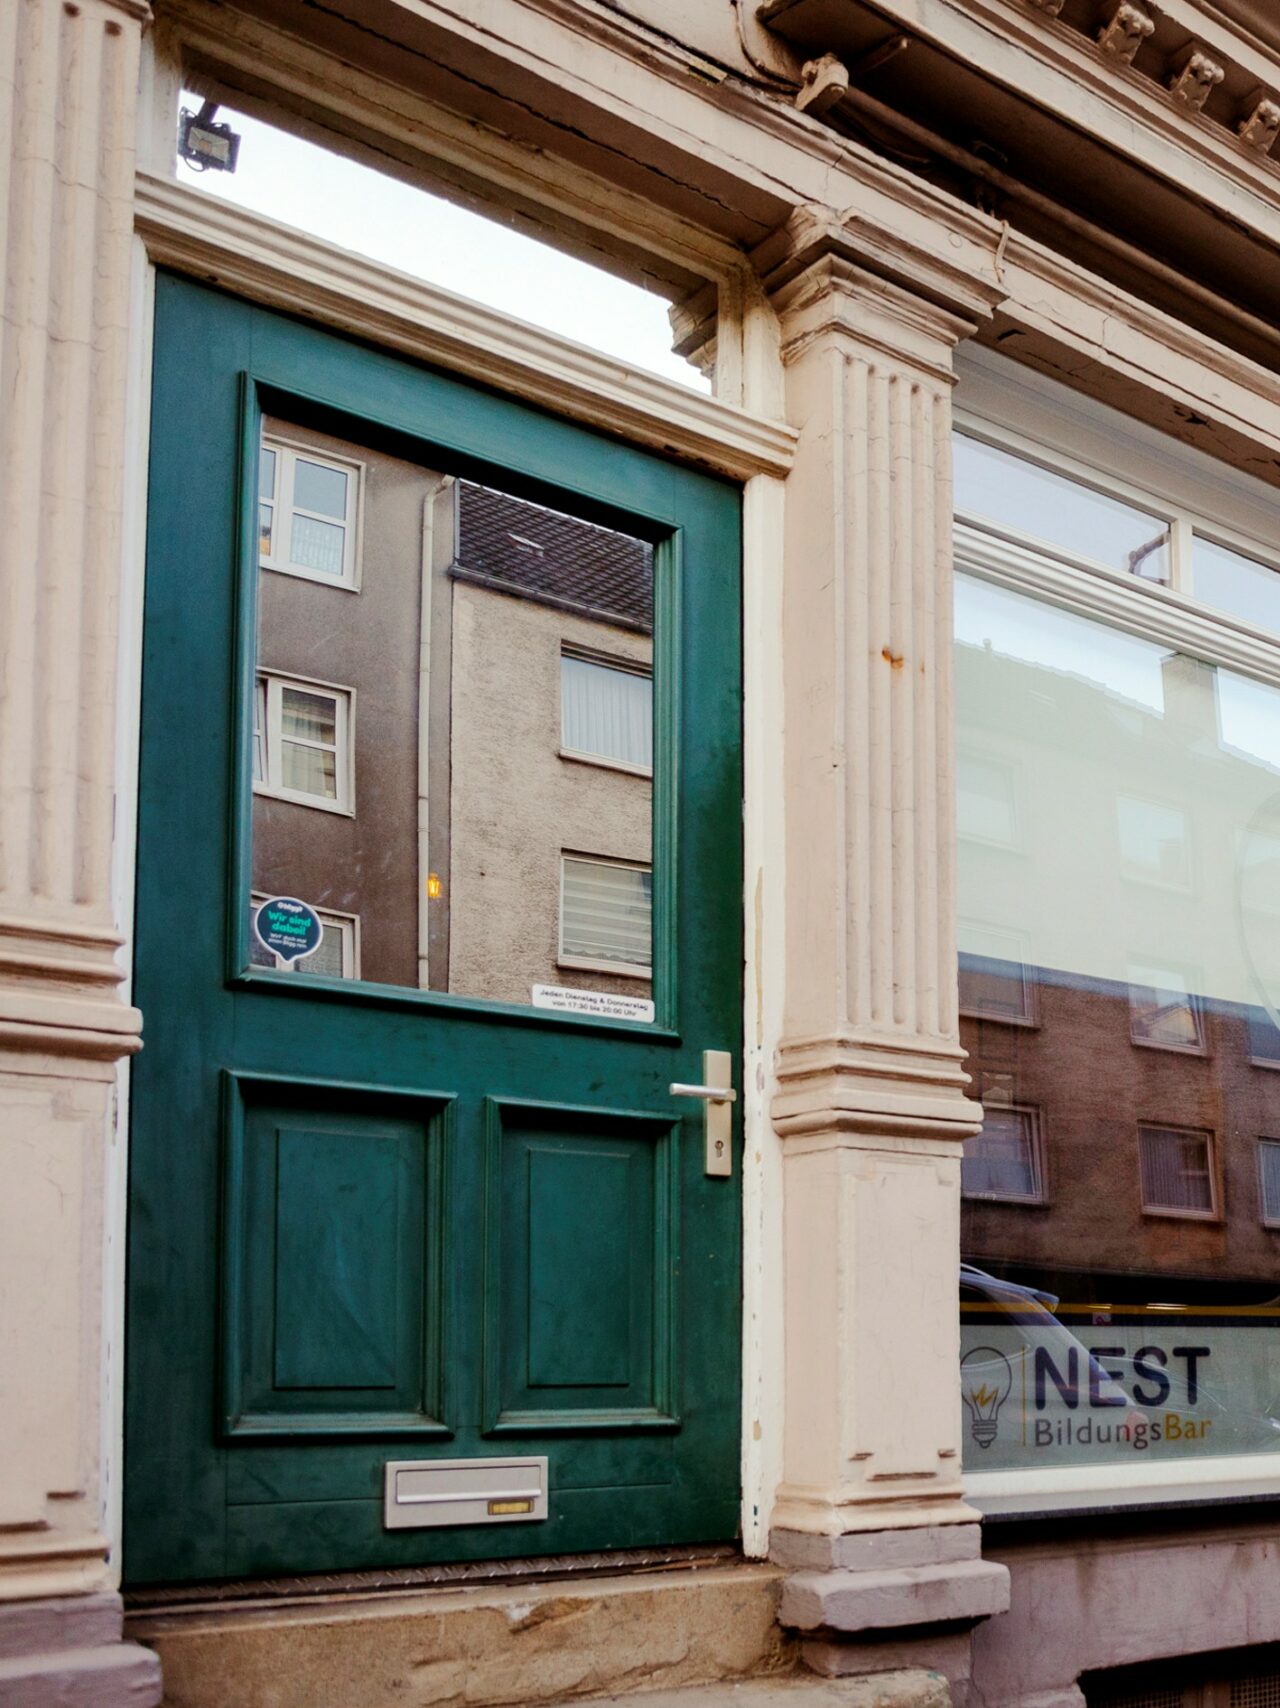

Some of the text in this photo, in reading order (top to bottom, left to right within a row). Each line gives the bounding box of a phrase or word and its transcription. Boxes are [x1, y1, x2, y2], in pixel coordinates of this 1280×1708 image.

[268, 911, 311, 927] Wir sind
[540, 989, 564, 998] Jeden
[565, 992, 598, 1003] Dienstag
[607, 998, 648, 1011] Donnerstag
[1034, 1346, 1210, 1410] NEST
[1035, 1413, 1212, 1450] BildungsBar
